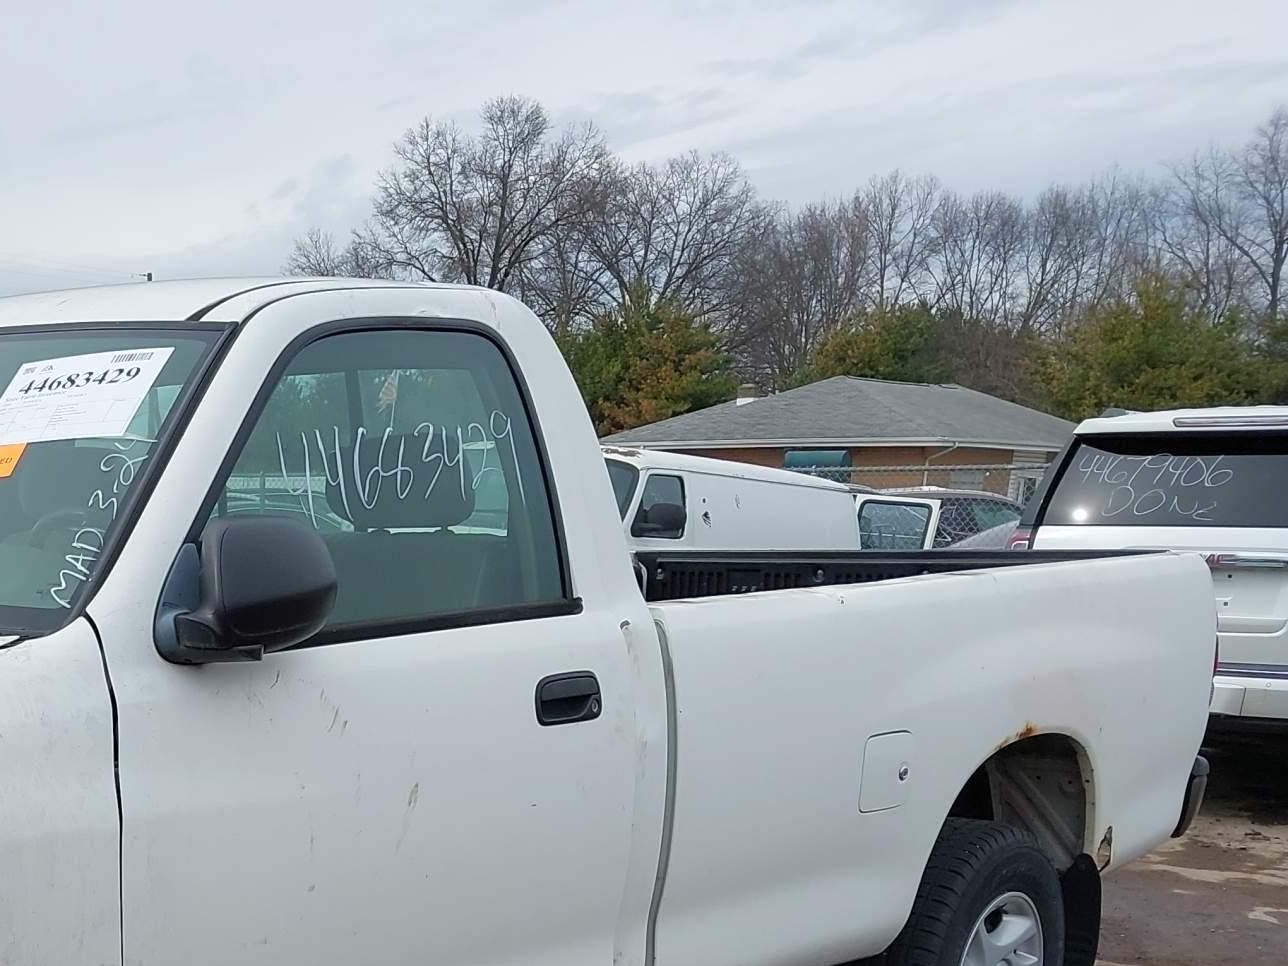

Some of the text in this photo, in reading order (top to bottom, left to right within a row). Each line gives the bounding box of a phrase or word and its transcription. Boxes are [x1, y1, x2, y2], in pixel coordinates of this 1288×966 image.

[19, 366, 142, 395] 44683429
[1079, 453, 1233, 488] 44679406
[51, 528, 104, 608] MAD
